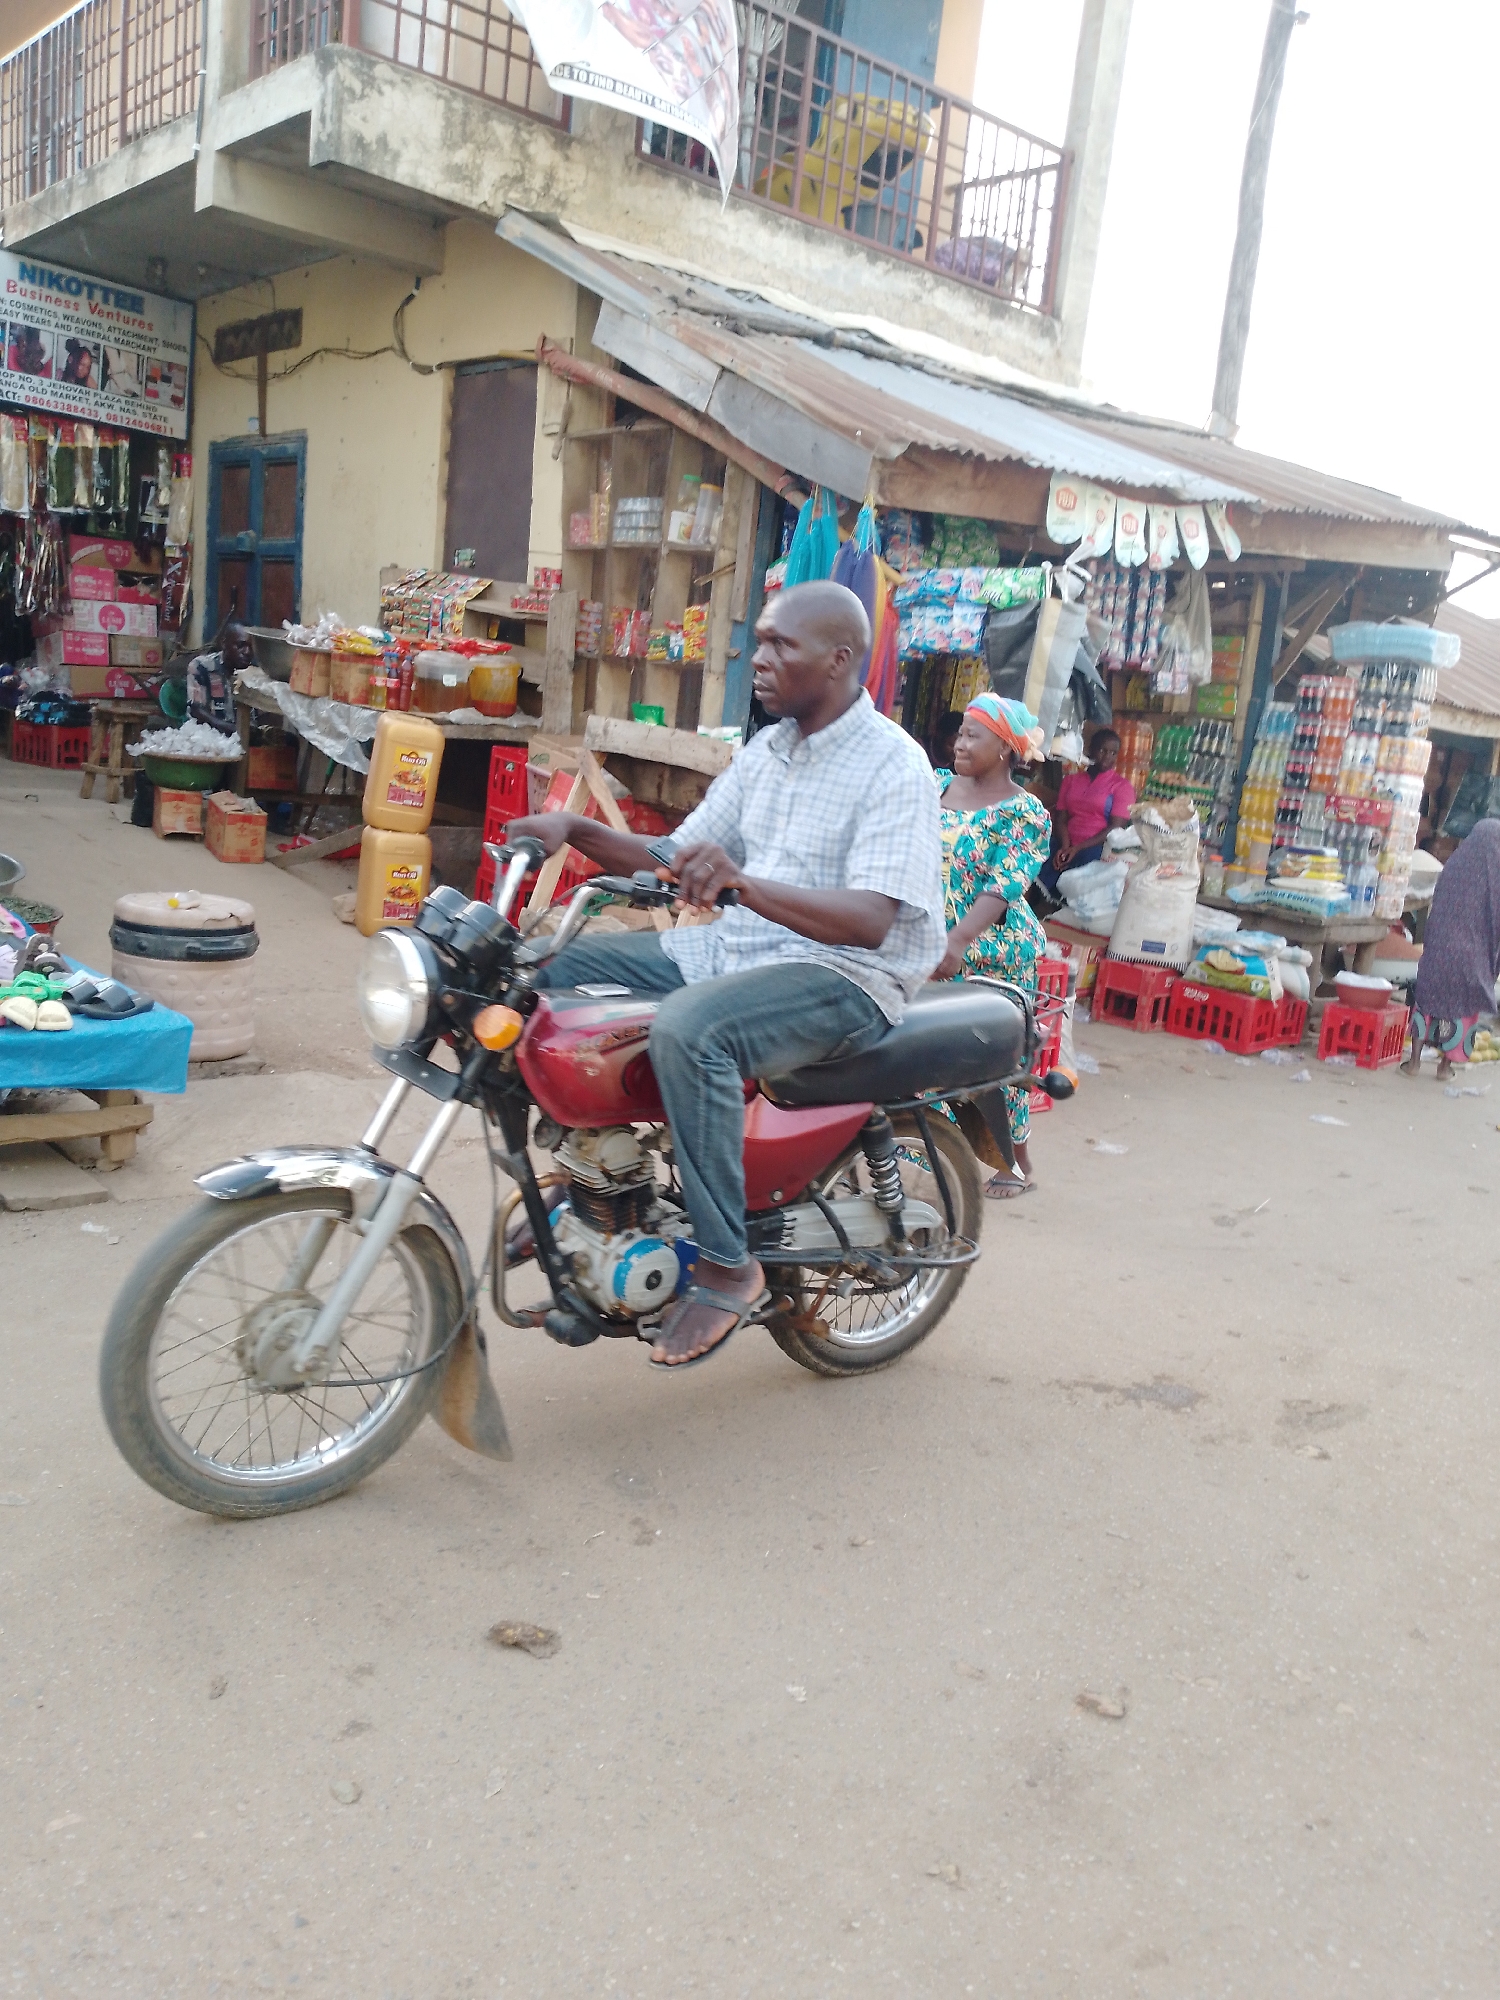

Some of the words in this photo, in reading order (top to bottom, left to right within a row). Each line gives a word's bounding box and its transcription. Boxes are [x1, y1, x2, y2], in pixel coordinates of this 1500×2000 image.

[573, 66, 588, 83] TO
[589, 70, 614, 91] FIND
[615, 80, 653, 107] BEAUTY
[6, 279, 80, 312] Business
[88, 301, 154, 332] Ventures
[19, 261, 145, 317] NIKOTTEE
[22, 312, 51, 327] WEARS
[55, 322, 72, 332] AND
[74, 326, 111, 342] GENERAL
[114, 337, 157, 354] MARCHANT
[28, 385, 48, 395] OLD
[142, 411, 169, 423] STATE
[47, 381, 91, 397] JEHOVAH
[94, 391, 122, 404] PLAZA
[124, 400, 158, 412] BEHIND
